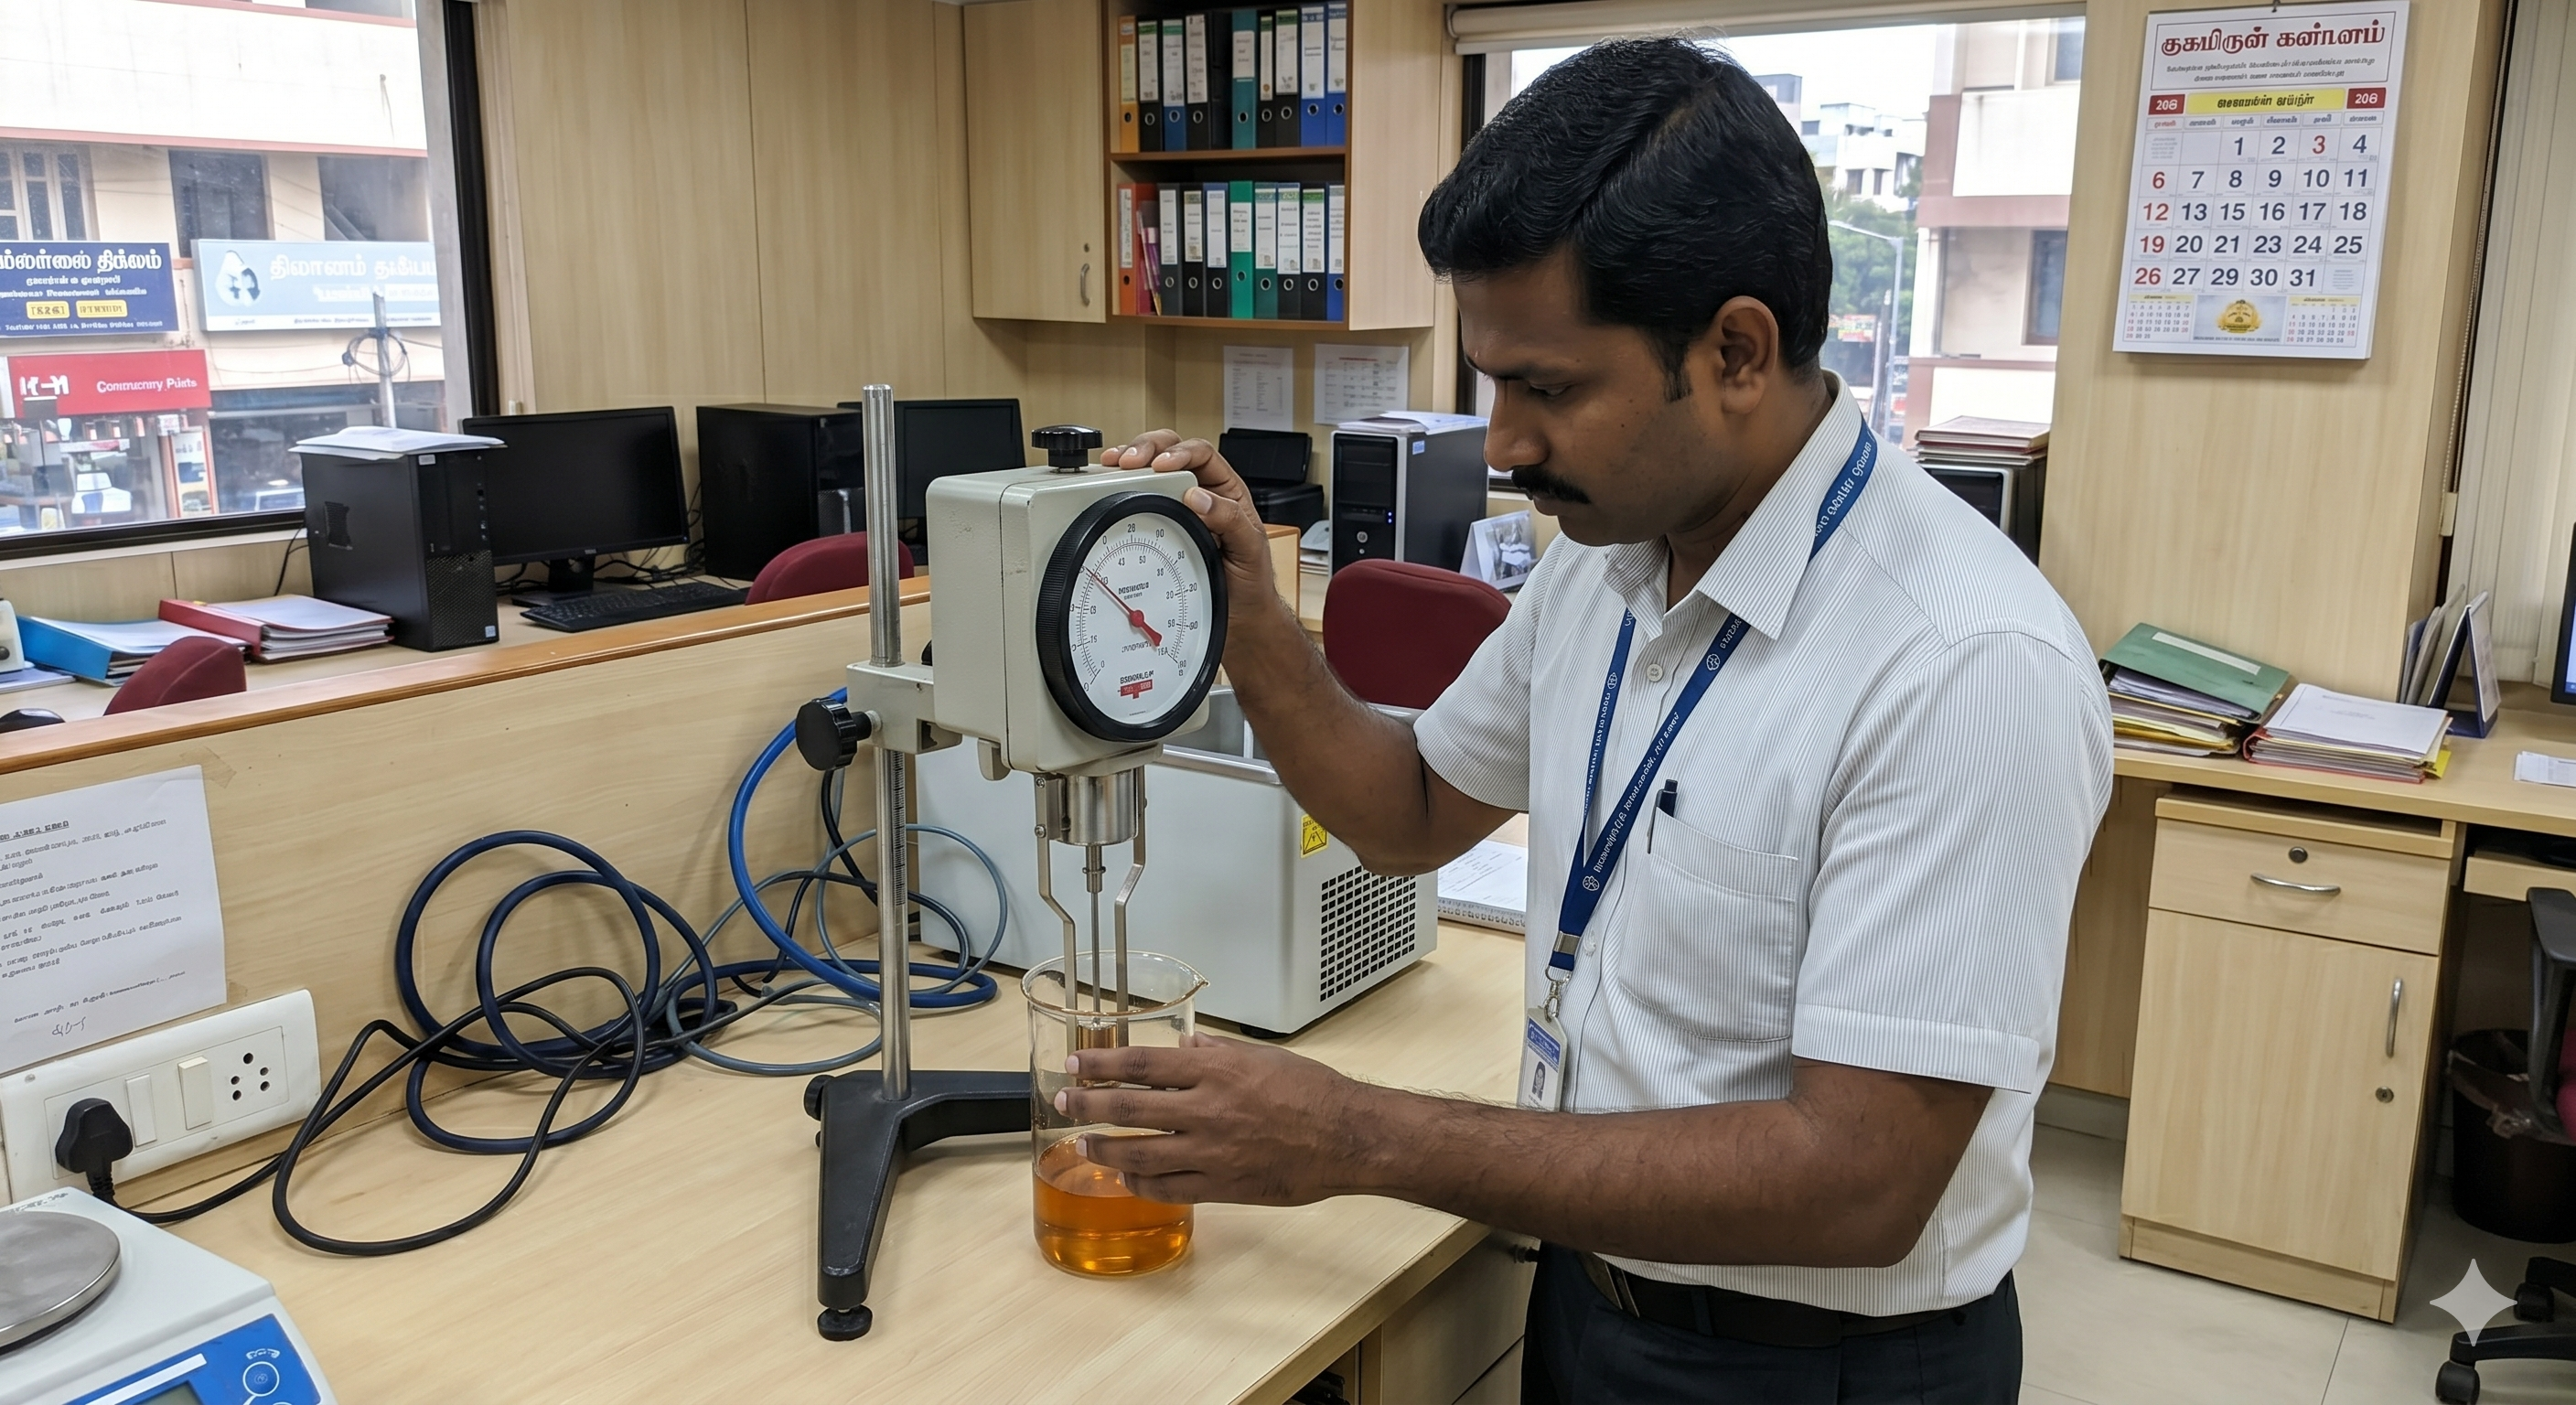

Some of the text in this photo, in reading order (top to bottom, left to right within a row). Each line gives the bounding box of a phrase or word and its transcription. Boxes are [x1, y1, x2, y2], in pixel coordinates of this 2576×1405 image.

[2234, 134, 2367, 156] 1 2 3 4
[2152, 168, 2367, 189] 6 7 8 9 10 11
[2143, 201, 2367, 221] 12 13 15 16 17 18
[2140, 235, 2363, 254] 19 20 21 23 24 25
[2134, 267, 2315, 287] 26 27 29 30 31
